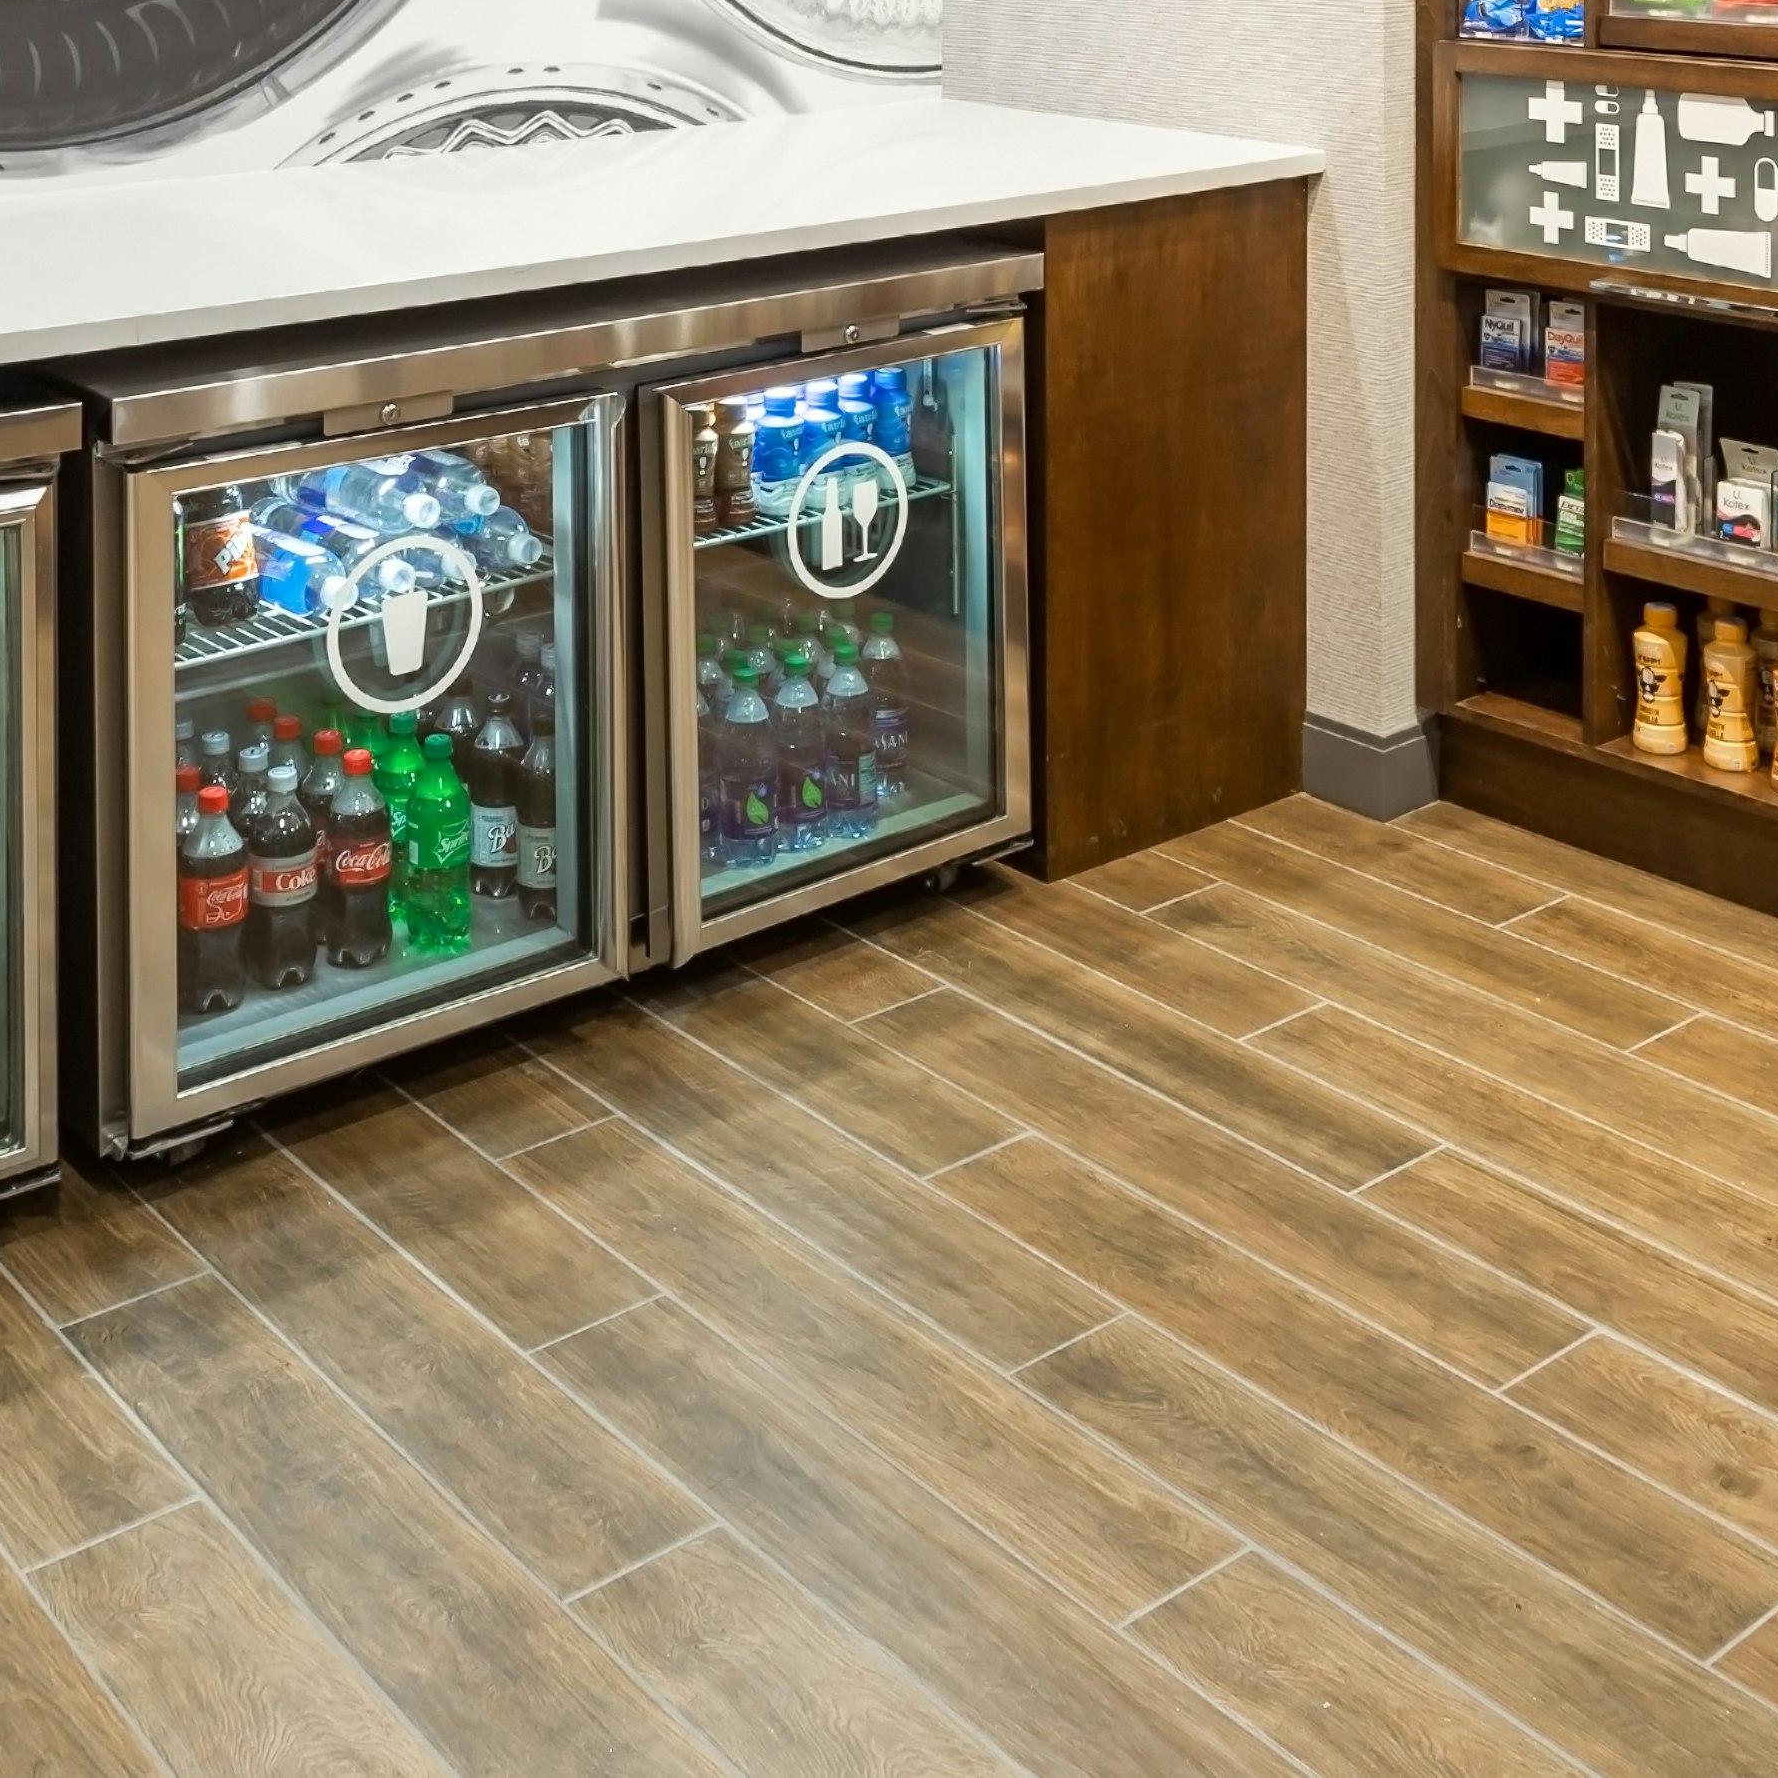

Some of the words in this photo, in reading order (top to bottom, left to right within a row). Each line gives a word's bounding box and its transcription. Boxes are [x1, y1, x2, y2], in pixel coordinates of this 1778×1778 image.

[1485, 319, 1515, 333] NyQuil
[1723, 498, 1751, 512] Kotex
[276, 868, 317, 891] Coke
